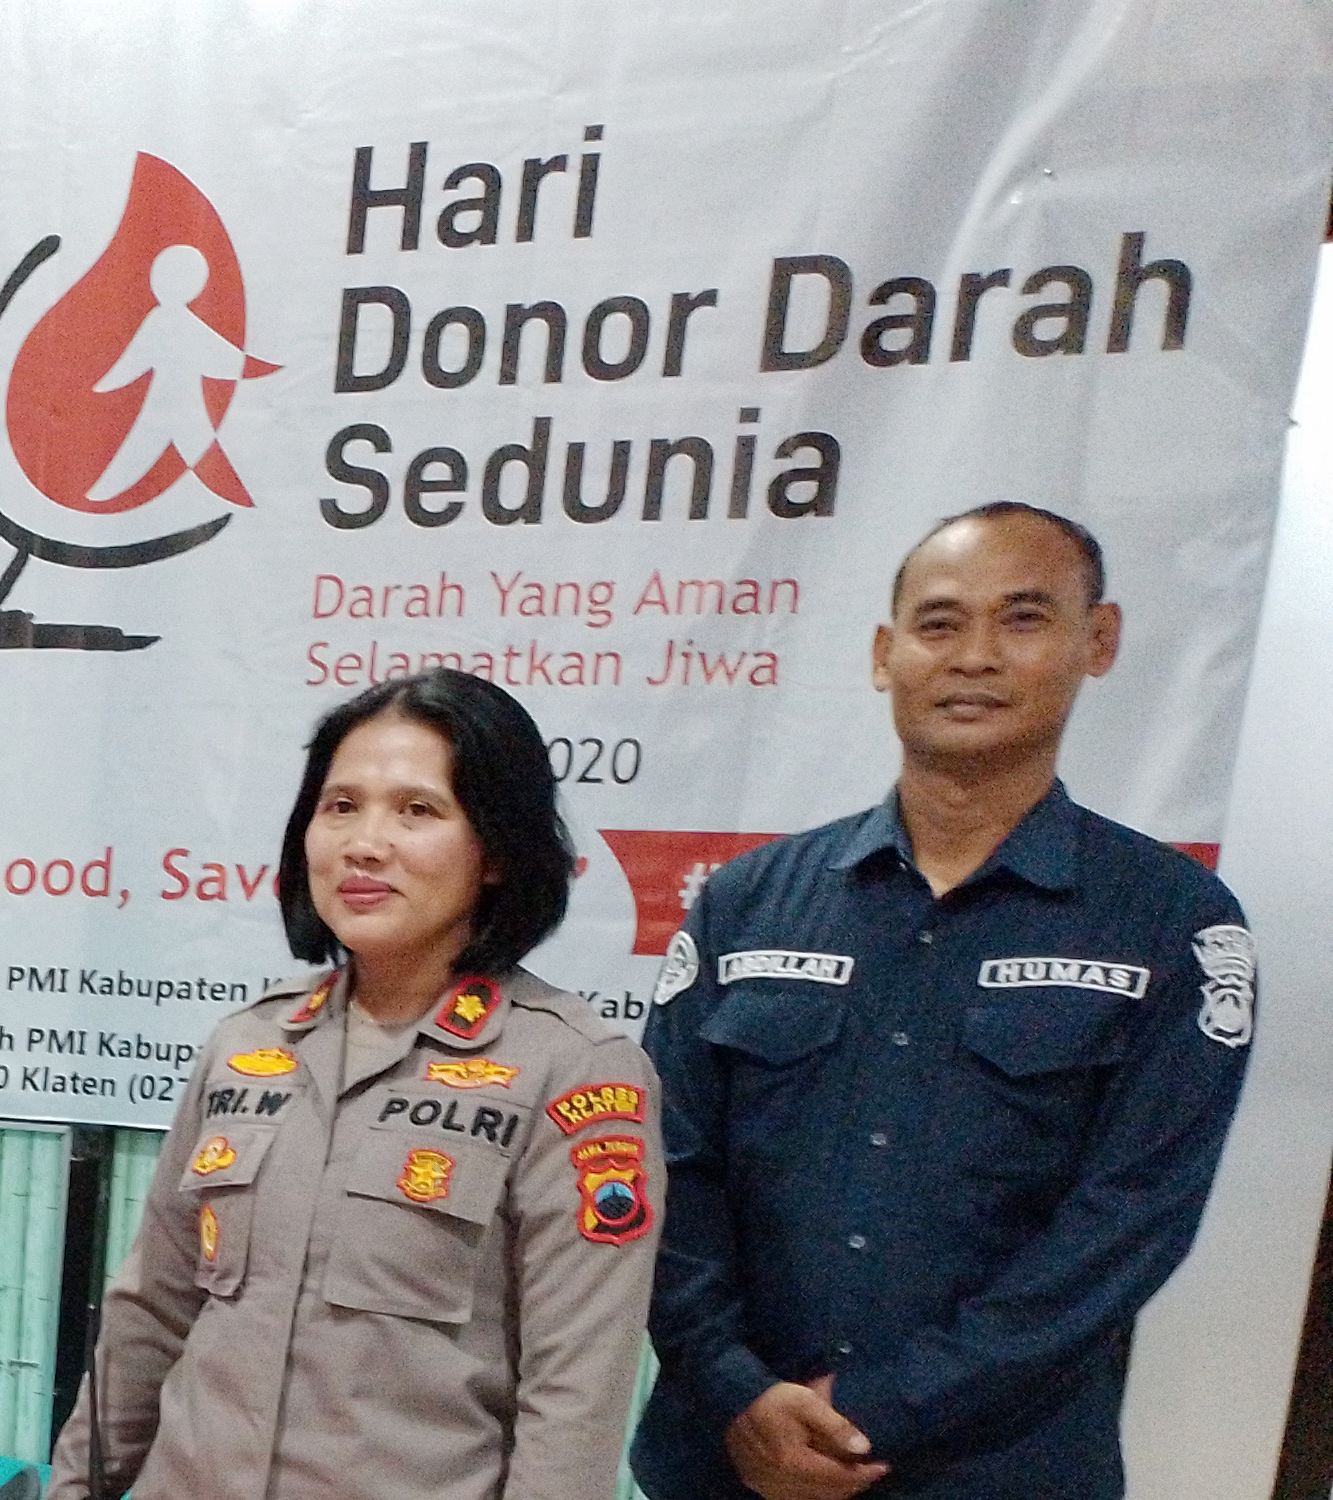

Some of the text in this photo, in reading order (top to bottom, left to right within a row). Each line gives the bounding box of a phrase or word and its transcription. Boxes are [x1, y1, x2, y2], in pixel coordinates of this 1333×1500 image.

[345, 123, 605, 256] Hari
[333, 231, 1194, 395] Donor Darah
[319, 406, 842, 530] Sedunia
[312, 569, 801, 629] Darah Yang Aman
[645, 638, 779, 688] Jiwa
[546, 737, 642, 785] 020
[161, 848, 280, 902] Sav
[7, 966, 69, 995] PMI
[79, 969, 248, 1007] Kabupaten
[995, 961, 1133, 990] HUMAS
[26, 1028, 86, 1056] PMI
[97, 1031, 203, 1071] Kabup
[22, 1067, 117, 1097] Klaten
[377, 1097, 520, 1148] POLRI
